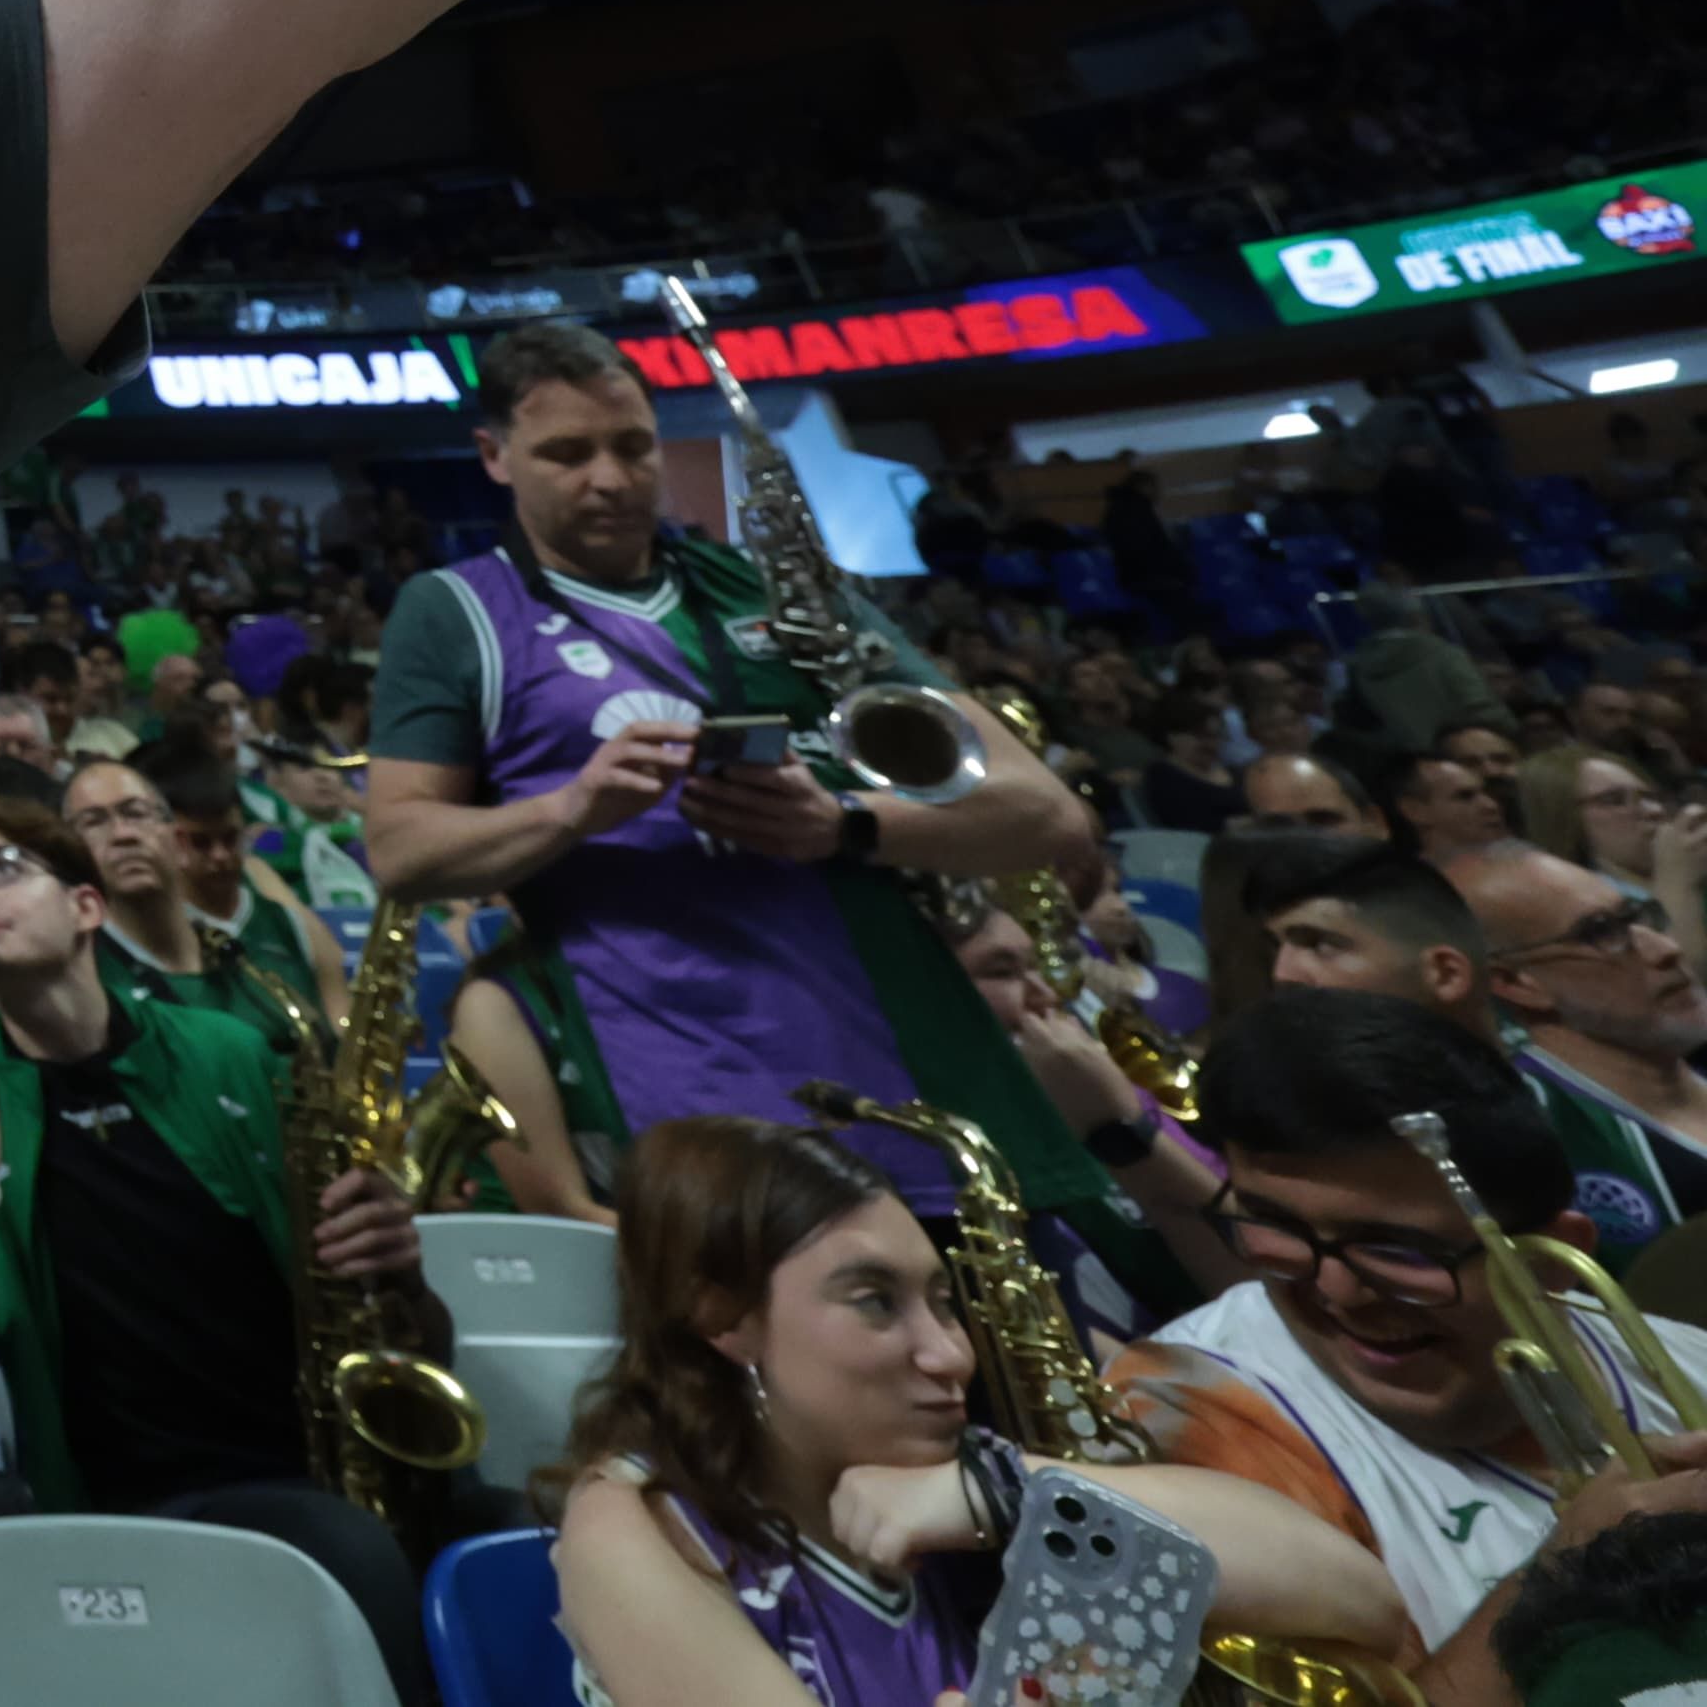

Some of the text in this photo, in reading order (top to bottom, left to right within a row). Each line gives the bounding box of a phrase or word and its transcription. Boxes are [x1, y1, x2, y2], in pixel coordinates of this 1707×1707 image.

[147, 348, 462, 410] UNICAJA
[713, 286, 1148, 381] MANRESA
[82, 1586, 128, 1620] 23
